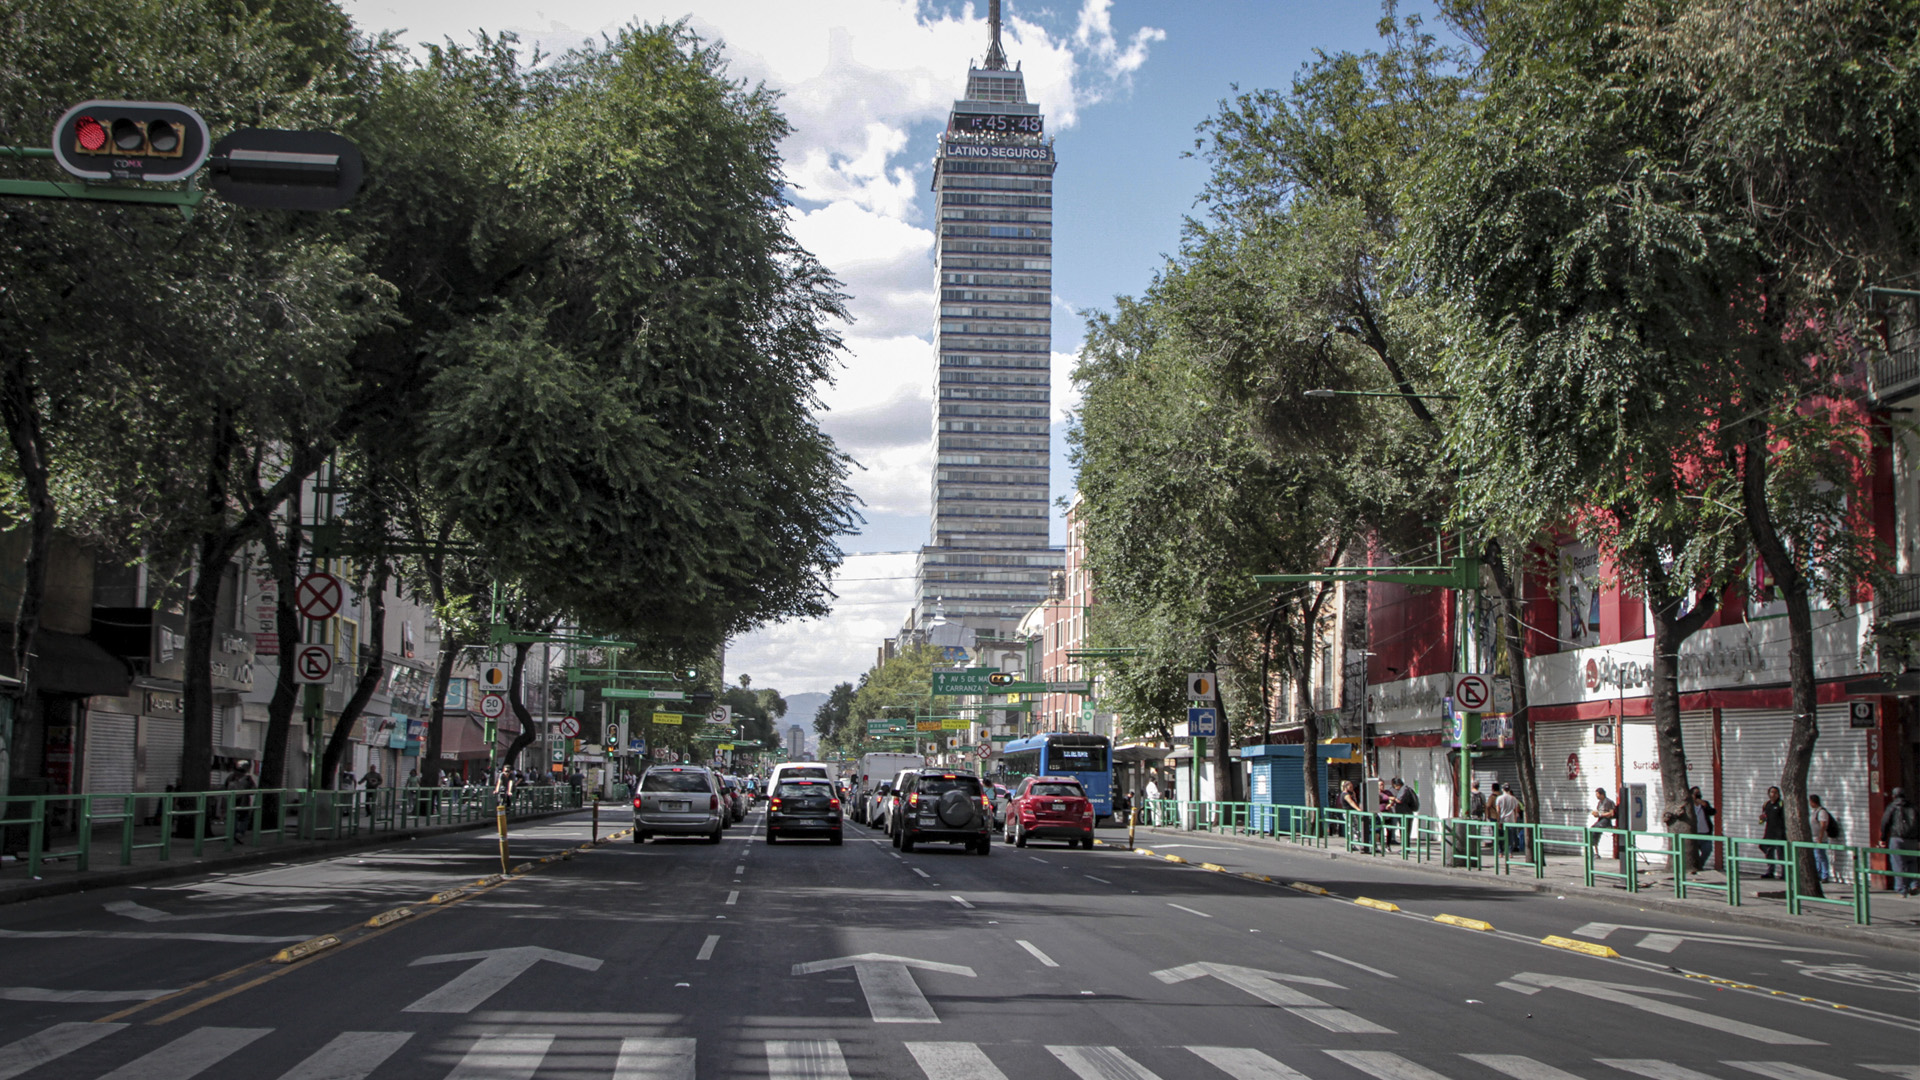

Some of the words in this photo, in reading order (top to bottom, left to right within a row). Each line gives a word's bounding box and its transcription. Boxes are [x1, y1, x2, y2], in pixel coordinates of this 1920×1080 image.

[947, 145, 988, 156] LATINO
[991, 147, 1047, 159] SEGUROS
[1573, 553, 1597, 571] Repara
[485, 699, 499, 708] 50
